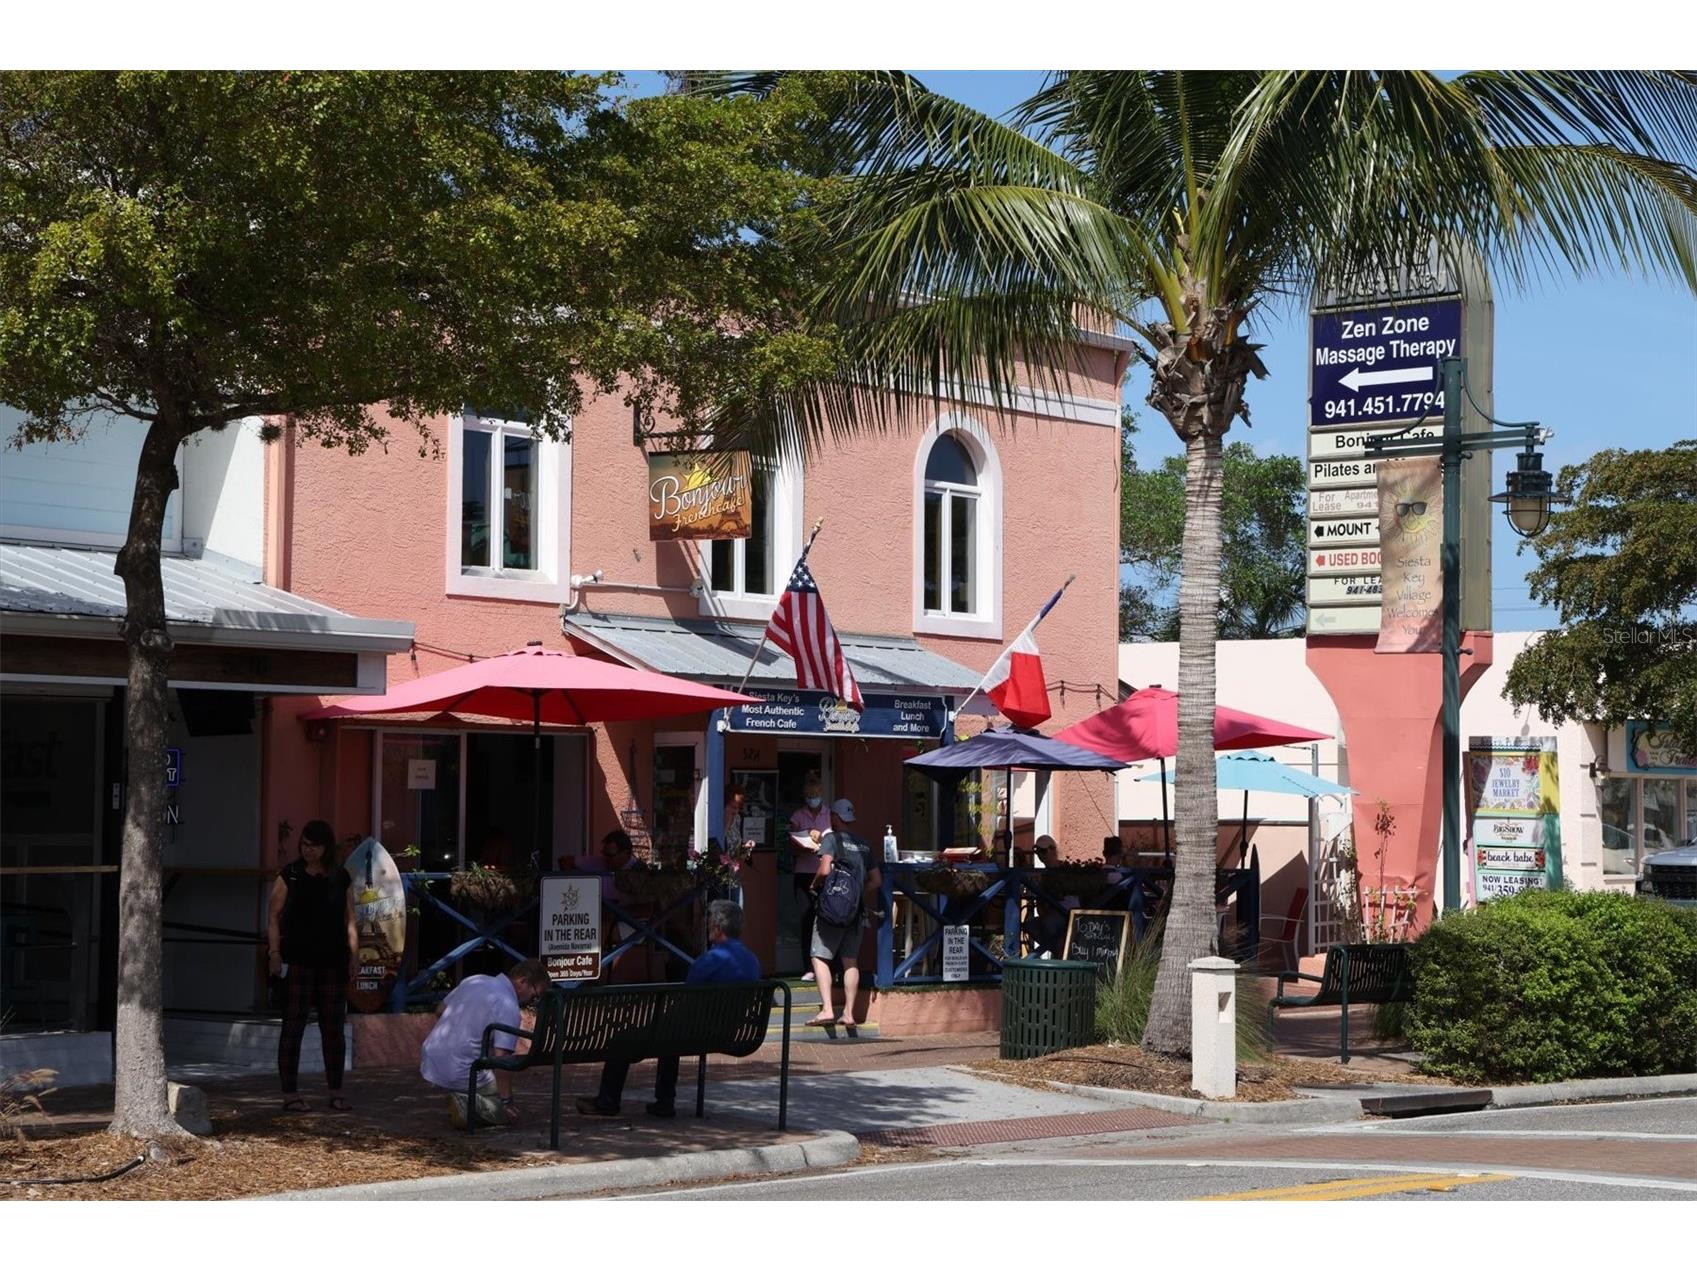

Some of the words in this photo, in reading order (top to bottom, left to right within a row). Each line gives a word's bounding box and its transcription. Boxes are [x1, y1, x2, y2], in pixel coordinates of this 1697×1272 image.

[1341, 320, 1376, 339] Zen
[1381, 316, 1430, 335] Zone
[1316, 346, 1386, 366] Massage
[1389, 338, 1456, 361] Therapy
[1324, 391, 1445, 419] 941.451.7794
[1314, 463, 1360, 478] Pilates
[650, 475, 745, 520] Bonjour
[1318, 492, 1336, 503] For
[1312, 502, 1342, 512] Lease
[1327, 522, 1371, 537] MOUNT
[1328, 552, 1358, 567] USED
[1396, 556, 1431, 568] Siesta
[1334, 577, 1356, 585] FOR
[1403, 572, 1425, 587] Key
[1396, 585, 1432, 605] Village
[1402, 625, 1424, 635] You
[748, 691, 775, 702] Siesta
[777, 693, 800, 704] Key's
[741, 704, 763, 714] Most
[764, 705, 805, 716] Authentic
[894, 699, 932, 710] Breakfast
[900, 712, 925, 721] Lunch
[746, 718, 776, 728] French
[776, 719, 797, 729] Cafe
[893, 723, 908, 732] and
[910, 723, 930, 733] More
[1492, 788, 1520, 797] MARKET
[1487, 851, 1512, 862] beach
[1513, 852, 1534, 863] babe
[1482, 875, 1501, 883] NOW
[552, 913, 590, 926] PARKING
[544, 929, 554, 941] IN
[556, 929, 572, 941] THE
[574, 928, 597, 940] REAR
[945, 928, 968, 936] PARKING
[947, 937, 954, 945] IN
[948, 946, 963, 954] REAR
[547, 957, 575, 968] Bonjour
[576, 955, 593, 965] Cafe
[356, 980, 378, 991] LUNCH
